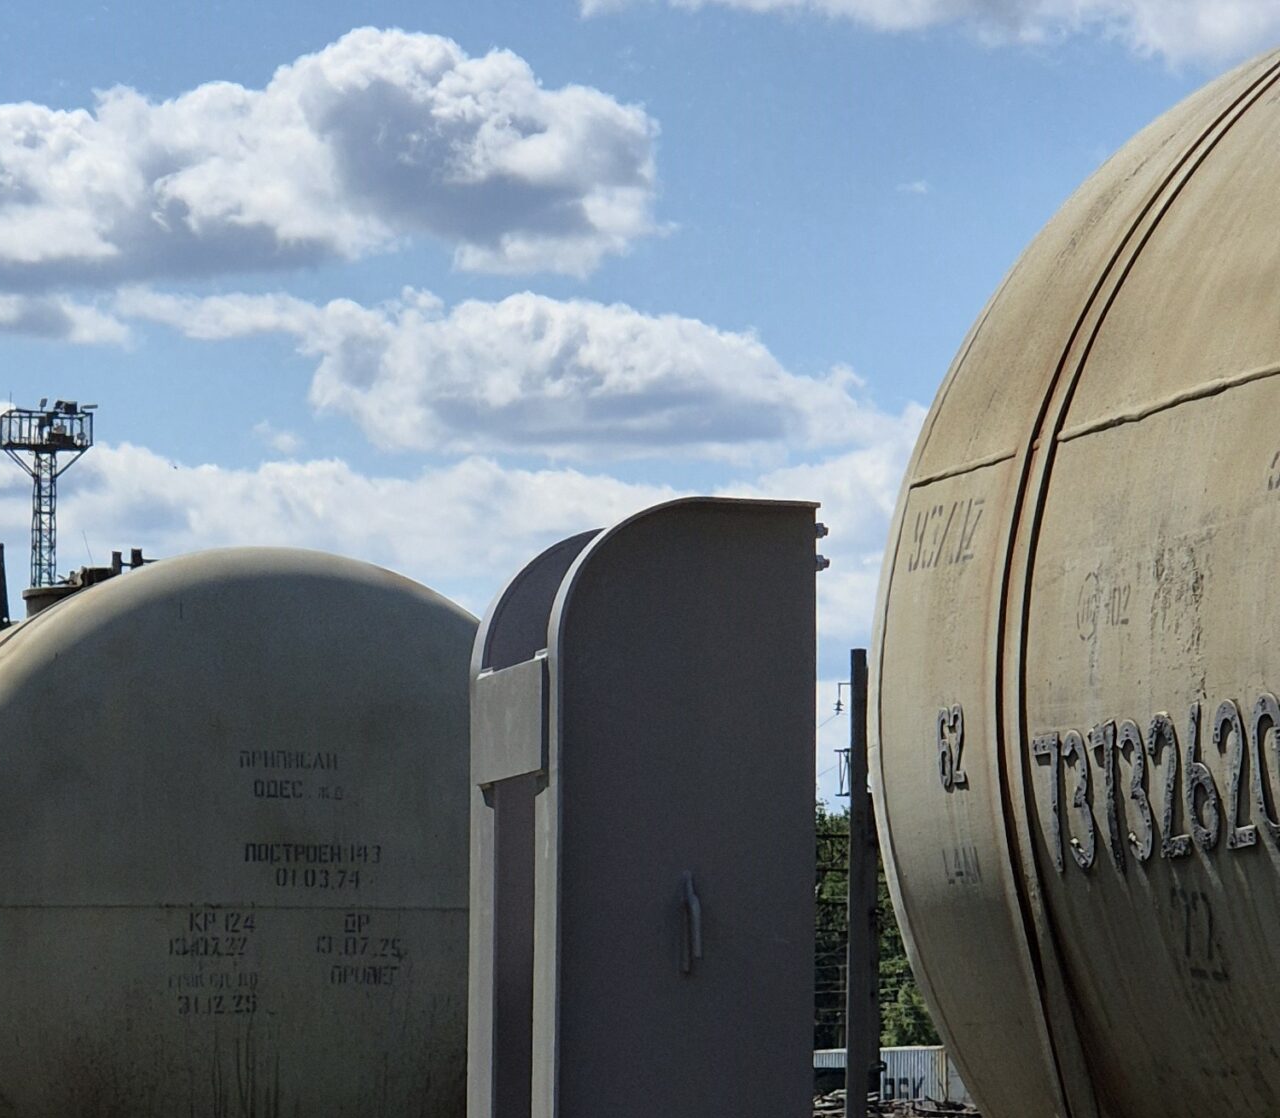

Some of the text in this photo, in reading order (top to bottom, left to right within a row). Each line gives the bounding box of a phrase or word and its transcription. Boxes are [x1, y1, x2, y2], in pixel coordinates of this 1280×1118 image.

[936, 703, 968, 792] 62
[239, 750, 339, 771] ПРИПИСАН
[243, 842, 342, 864] ПОСТРОЕН
[188, 911, 217, 933] КР
